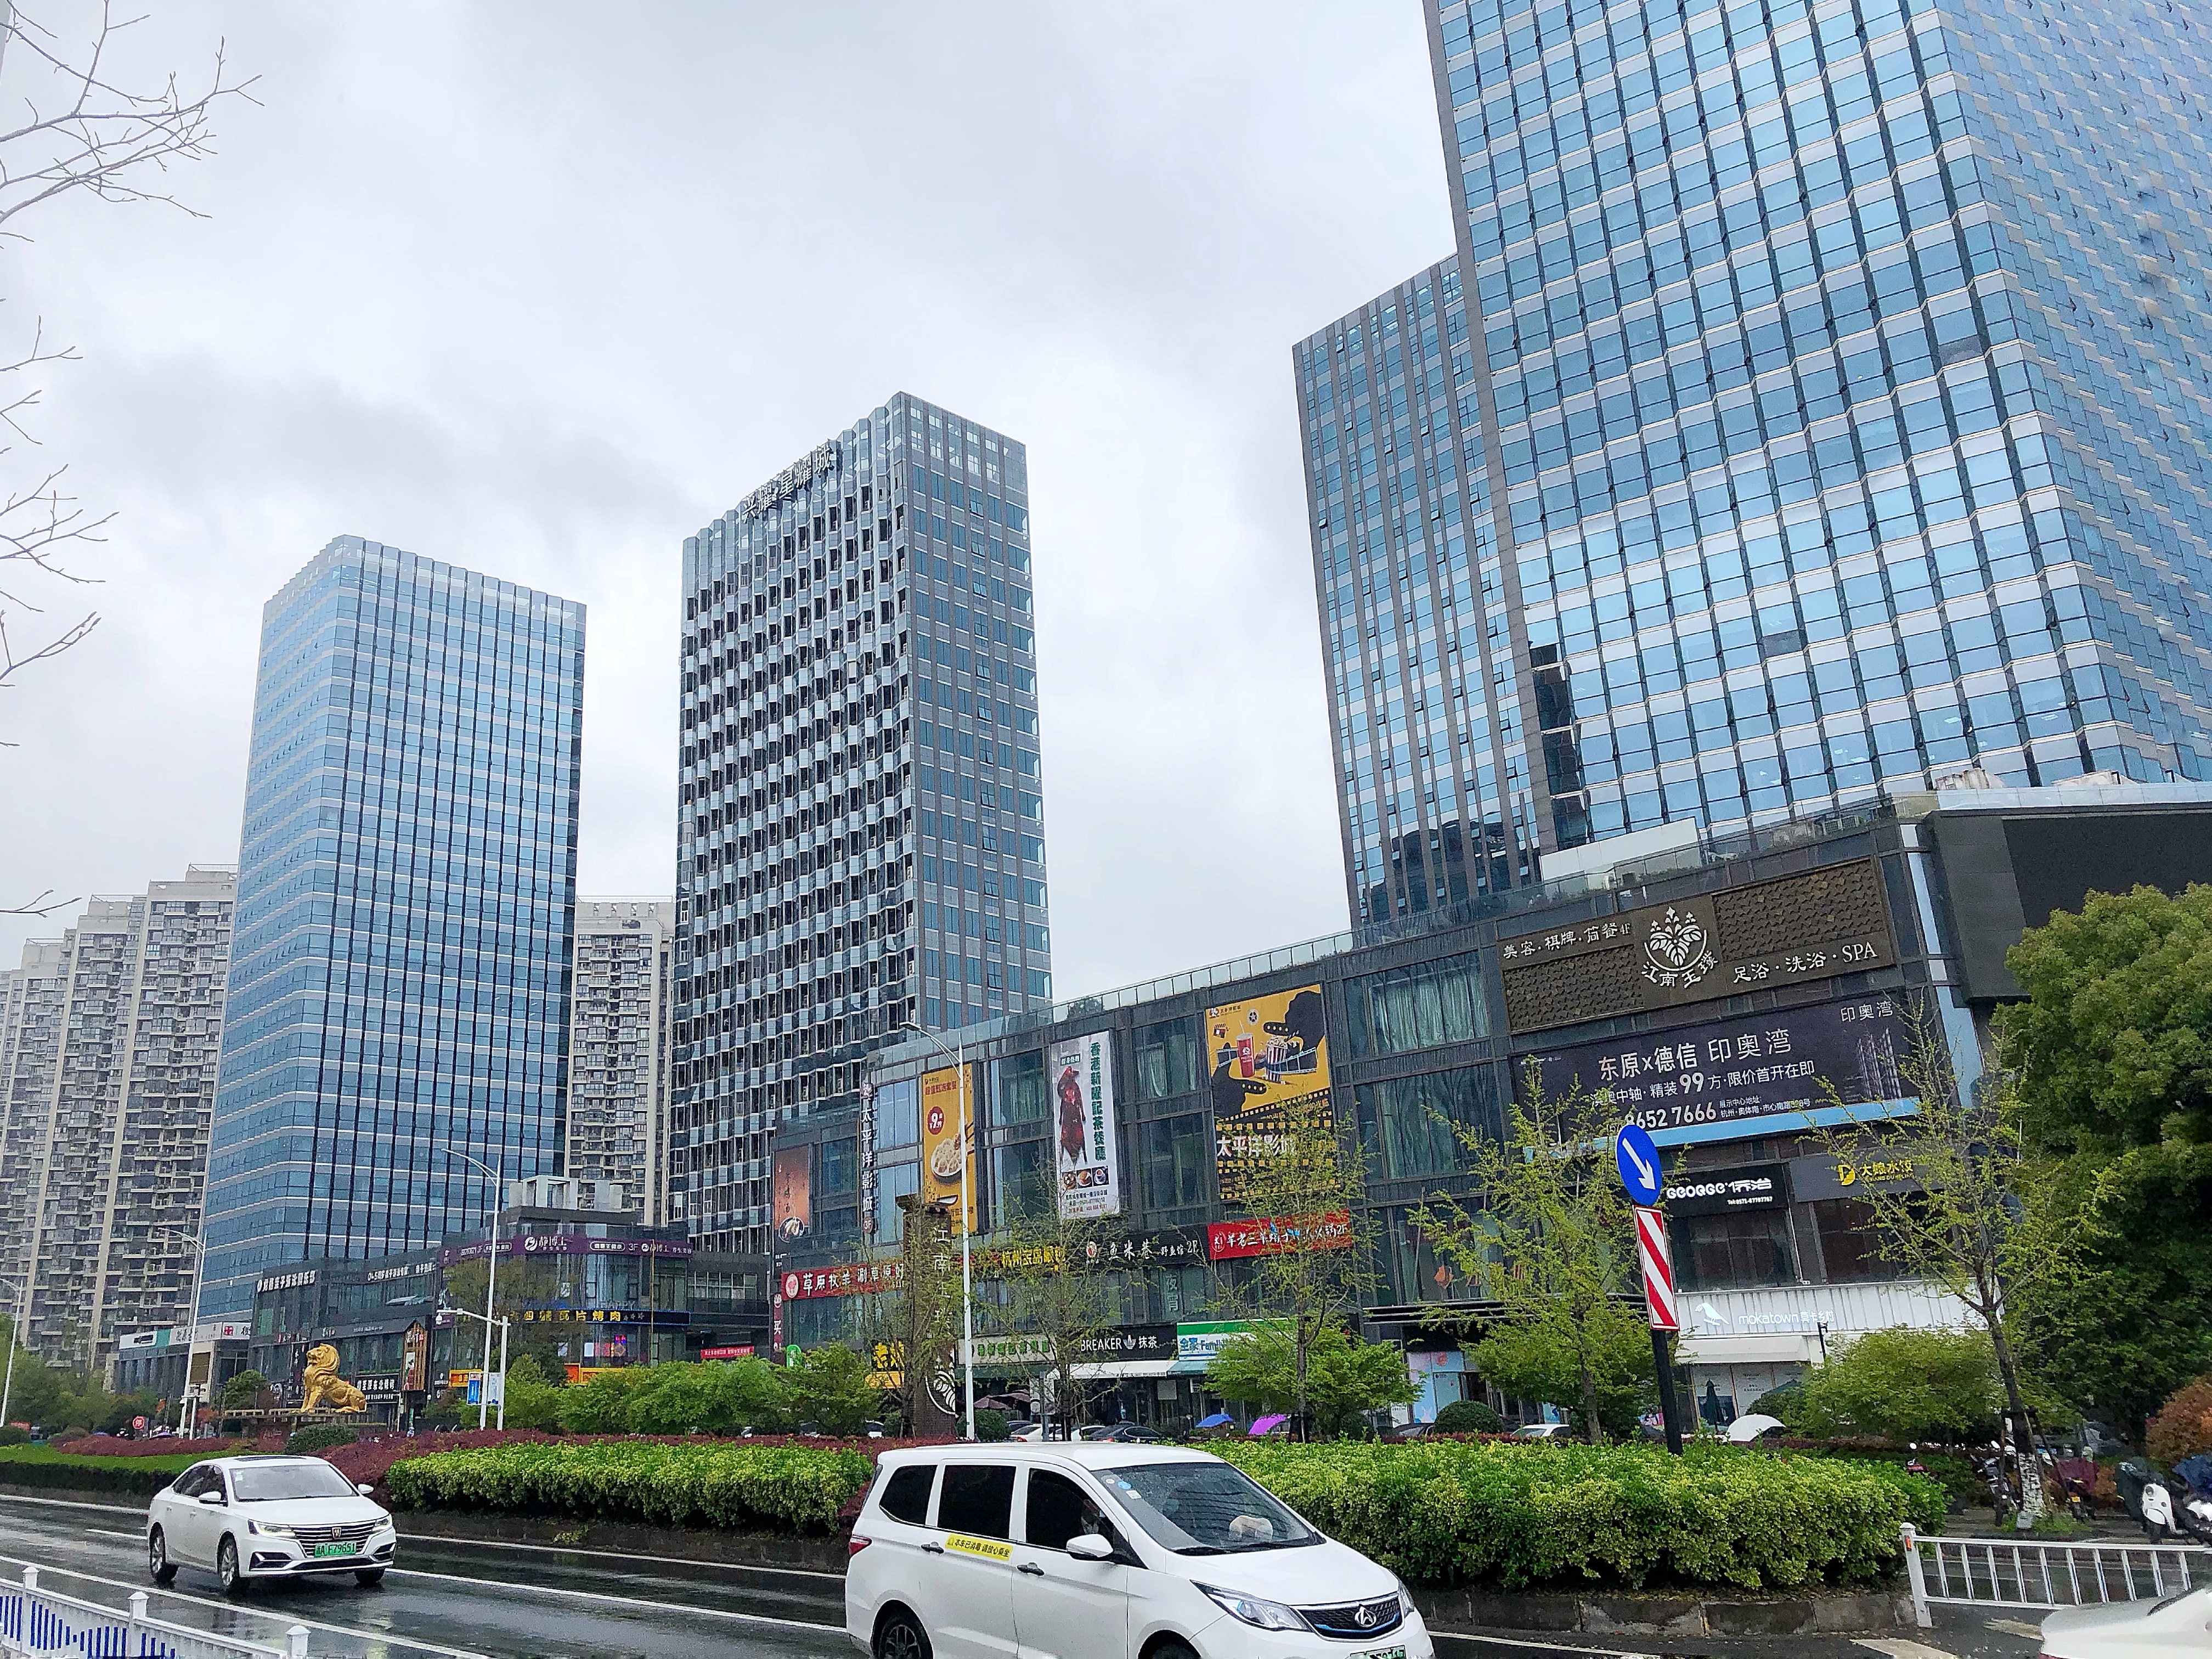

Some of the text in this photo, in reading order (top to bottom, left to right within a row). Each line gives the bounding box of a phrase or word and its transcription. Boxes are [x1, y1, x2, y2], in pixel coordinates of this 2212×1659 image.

[1841, 1001, 1893, 1023] 印奥湾
[1708, 1028, 1791, 1063] 印奥湾
[861, 1108, 873, 1212] 太平洋影城
[1165, 1274, 1179, 1312] 夜宵
[1739, 1312, 1799, 1325] mokatown
